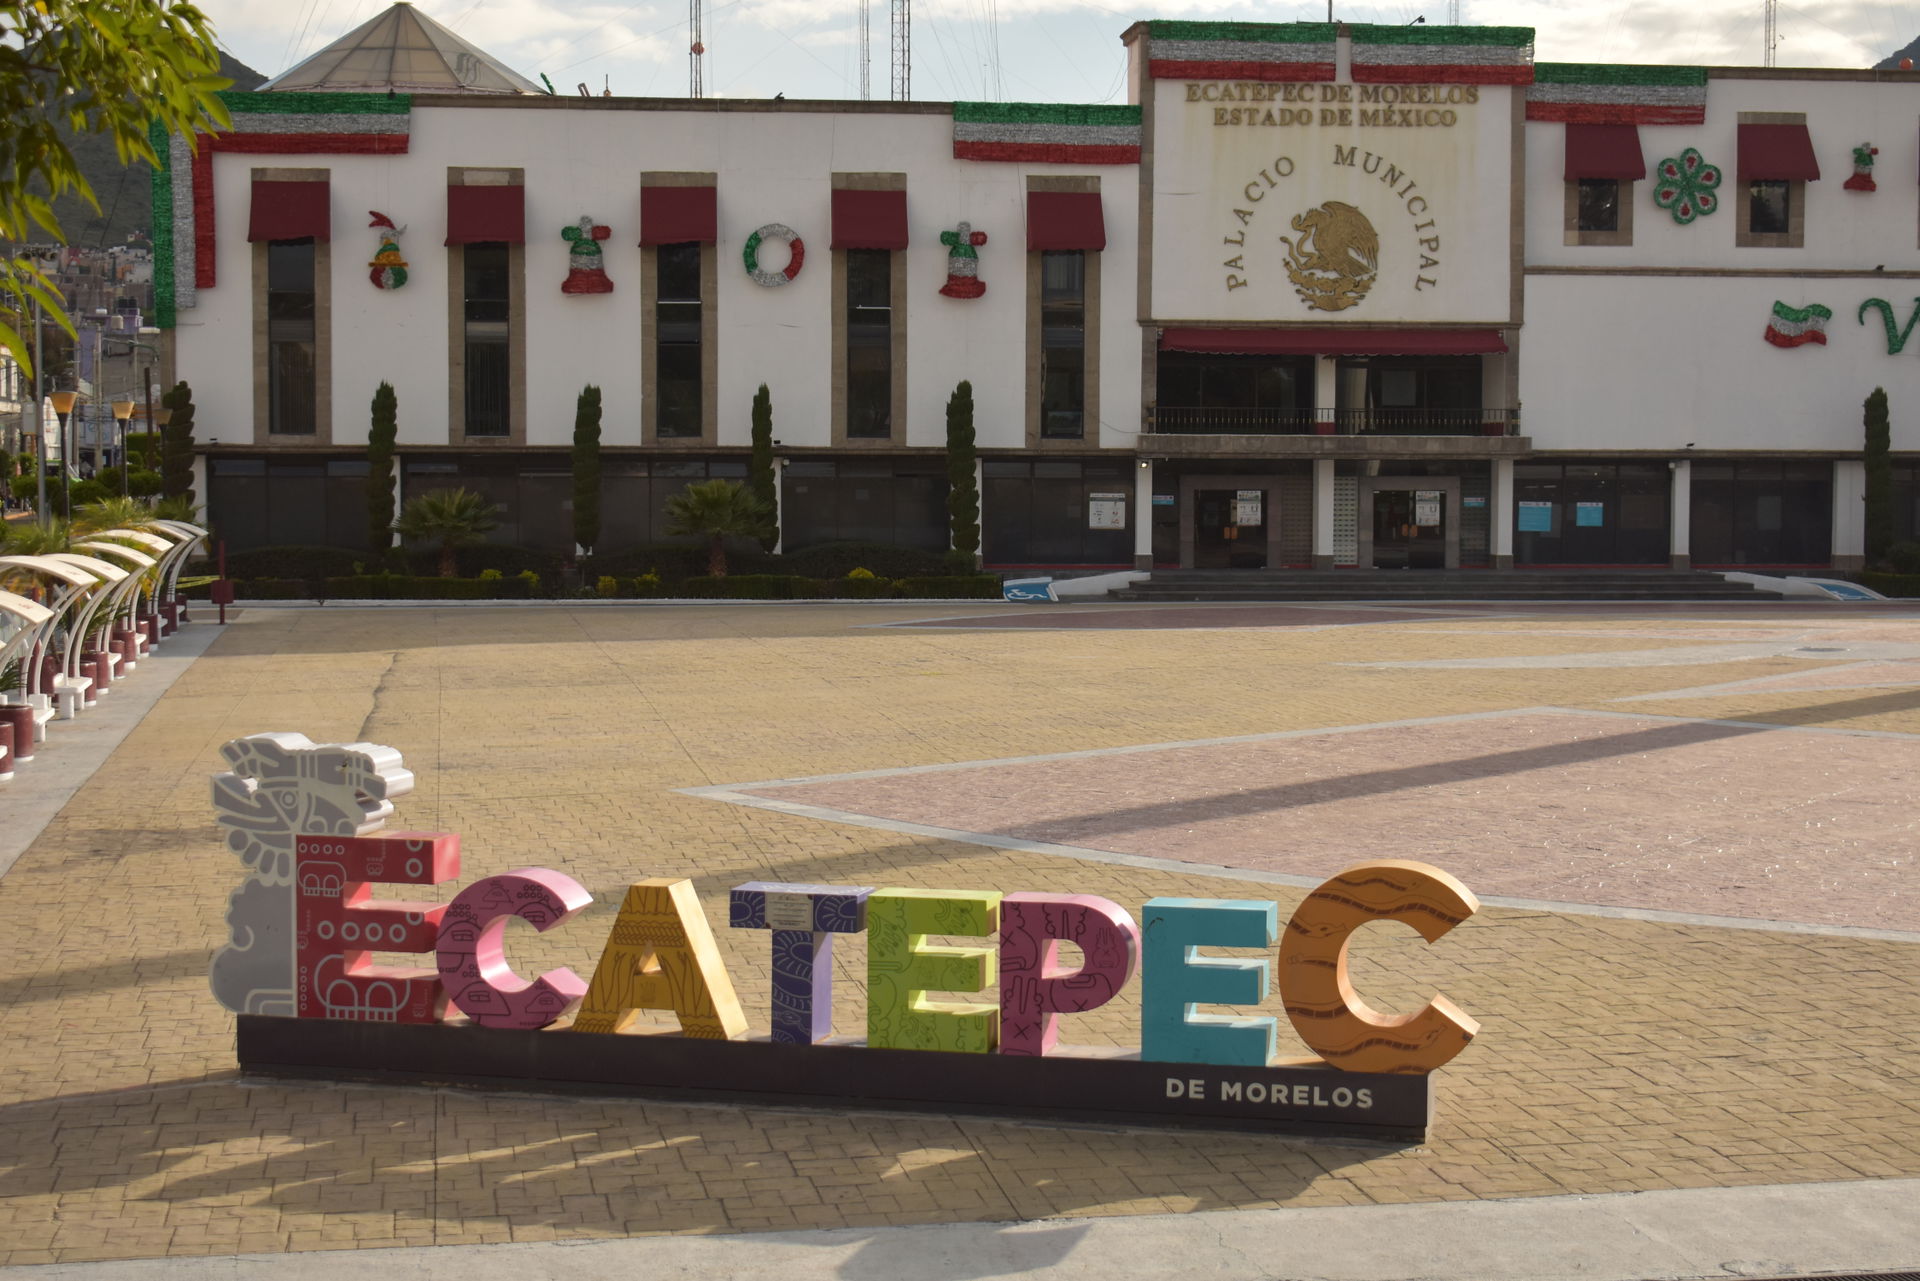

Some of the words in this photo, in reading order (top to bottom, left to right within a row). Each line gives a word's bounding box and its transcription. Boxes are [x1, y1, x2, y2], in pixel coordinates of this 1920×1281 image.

[1185, 83, 1315, 102] ECATEPEC
[1320, 84, 1353, 103] DE
[1359, 85, 1480, 104] MORELOS
[1213, 107, 1313, 126] ESTADO
[1320, 108, 1353, 127] DE
[1359, 105, 1457, 127] MÉXICO
[1223, 156, 1295, 292] PALACIO
[1333, 144, 1440, 292] MUNICIPAL
[296, 832, 1482, 1074] ECATEPEC
[1166, 1078, 1205, 1099] DE
[1221, 1081, 1373, 1109] MORELOS
